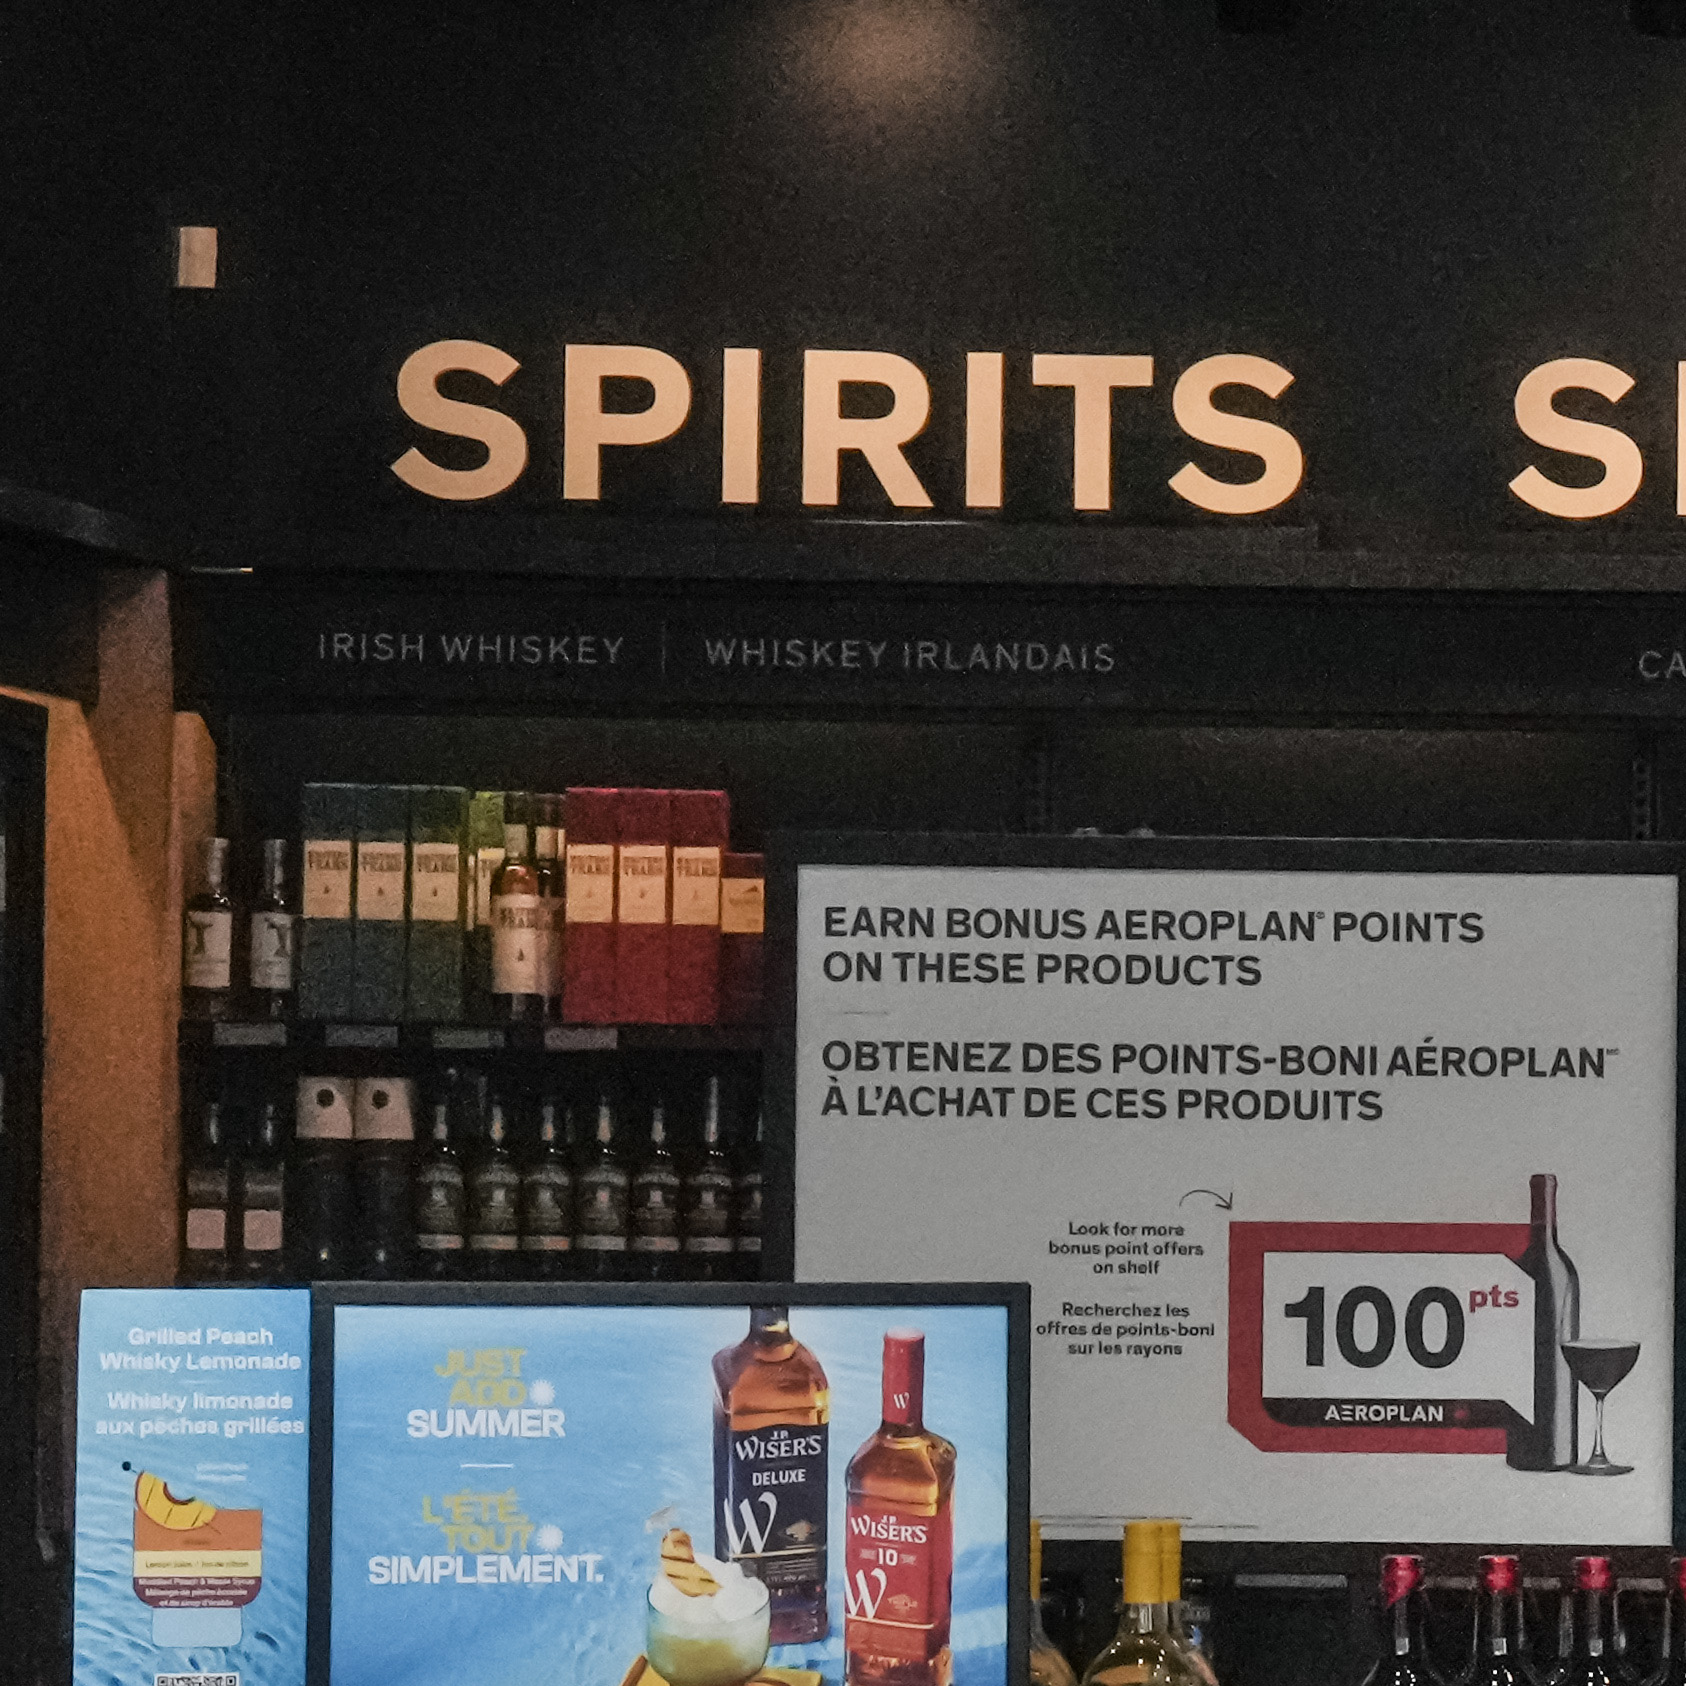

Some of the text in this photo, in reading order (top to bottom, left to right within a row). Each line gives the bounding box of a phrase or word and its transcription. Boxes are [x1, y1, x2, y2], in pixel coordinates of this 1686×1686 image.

[390, 339, 1305, 516] SPIRITS
[318, 632, 624, 668] IRISH WHISKEY
[704, 638, 1115, 674] WHISKEY IRLANDAIS
[824, 906, 935, 940] EARN
[946, 908, 1087, 941] BONUS
[1332, 911, 1485, 945] POINTS
[823, 951, 1262, 986] ON THESE PRODUCTS
[822, 1040, 1011, 1073] OBTENEZ
[1021, 1042, 1102, 1074] DES
[1112, 1044, 1379, 1077] POINTS-BONI
[821, 1077, 1383, 1122] À L'ACHAT DE CES PRODUITS
[1068, 1221, 1185, 1238] Look for more
[1049, 1240, 1204, 1260] bonus point offers
[1093, 1259, 1161, 1275] on shelf
[1062, 1303, 1190, 1319] Recherchez les
[1469, 1285, 1519, 1313] pts
[128, 1327, 273, 1346] Grilled Peach
[1036, 1321, 1215, 1341] offres de points-boni
[1283, 1286, 1466, 1369] 100
[100, 1352, 301, 1373] Whisky Lemonade
[435, 1348, 526, 1378] JUST
[1068, 1340, 1183, 1359] sur les rayons
[107, 1392, 293, 1413] Whisky limonade
[450, 1378, 526, 1407] ADD
[96, 1420, 134, 1434] aux
[224, 1416, 305, 1438] grillées
[407, 1409, 566, 1439] SUMMER
[1325, 1405, 1444, 1423] AEROPLAN
[735, 1434, 822, 1462] WISER'S
[752, 1469, 806, 1486] DELUXE
[441, 1524, 535, 1554] TOUT
[851, 1514, 928, 1544] WISER'S
[369, 1554, 604, 1585] SIMPLEMENT.
[877, 1548, 898, 1566] 10
